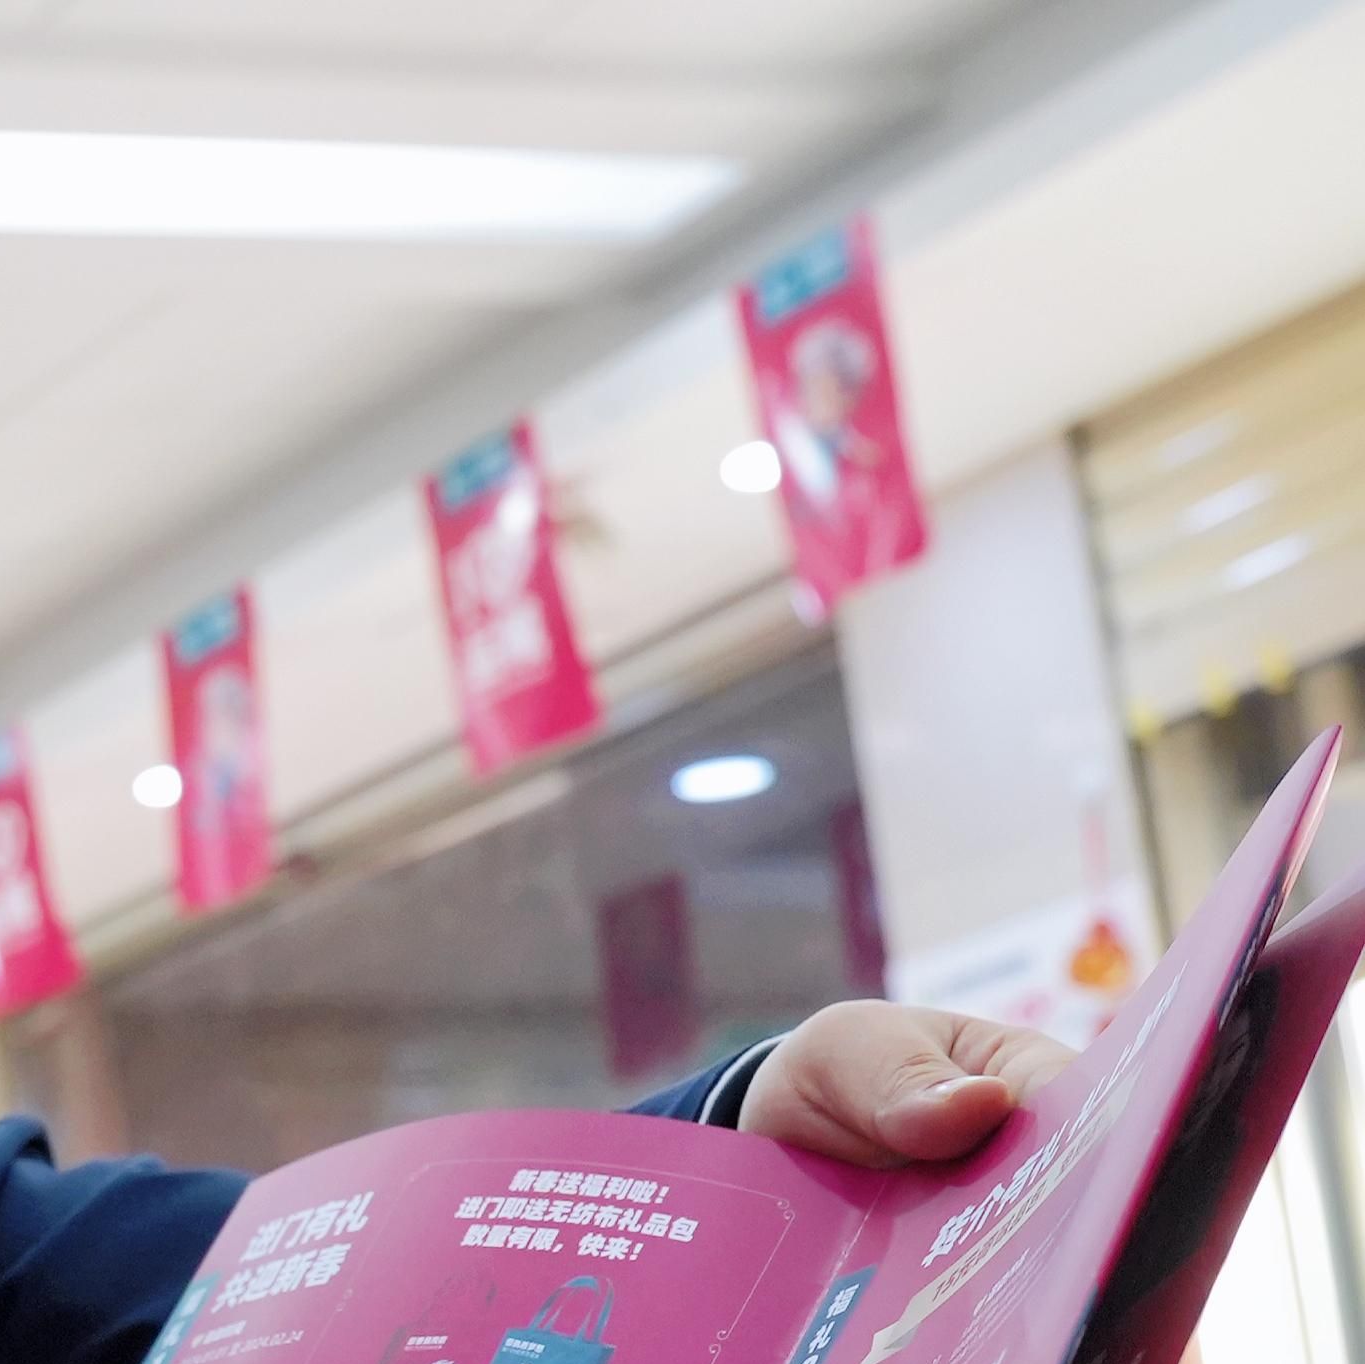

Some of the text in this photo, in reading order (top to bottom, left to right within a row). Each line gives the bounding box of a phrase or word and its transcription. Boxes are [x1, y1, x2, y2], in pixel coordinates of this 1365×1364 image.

[454, 1196, 698, 1242] 进门即送无纺布礼品包
[211, 1243, 352, 1314] 共迎新春
